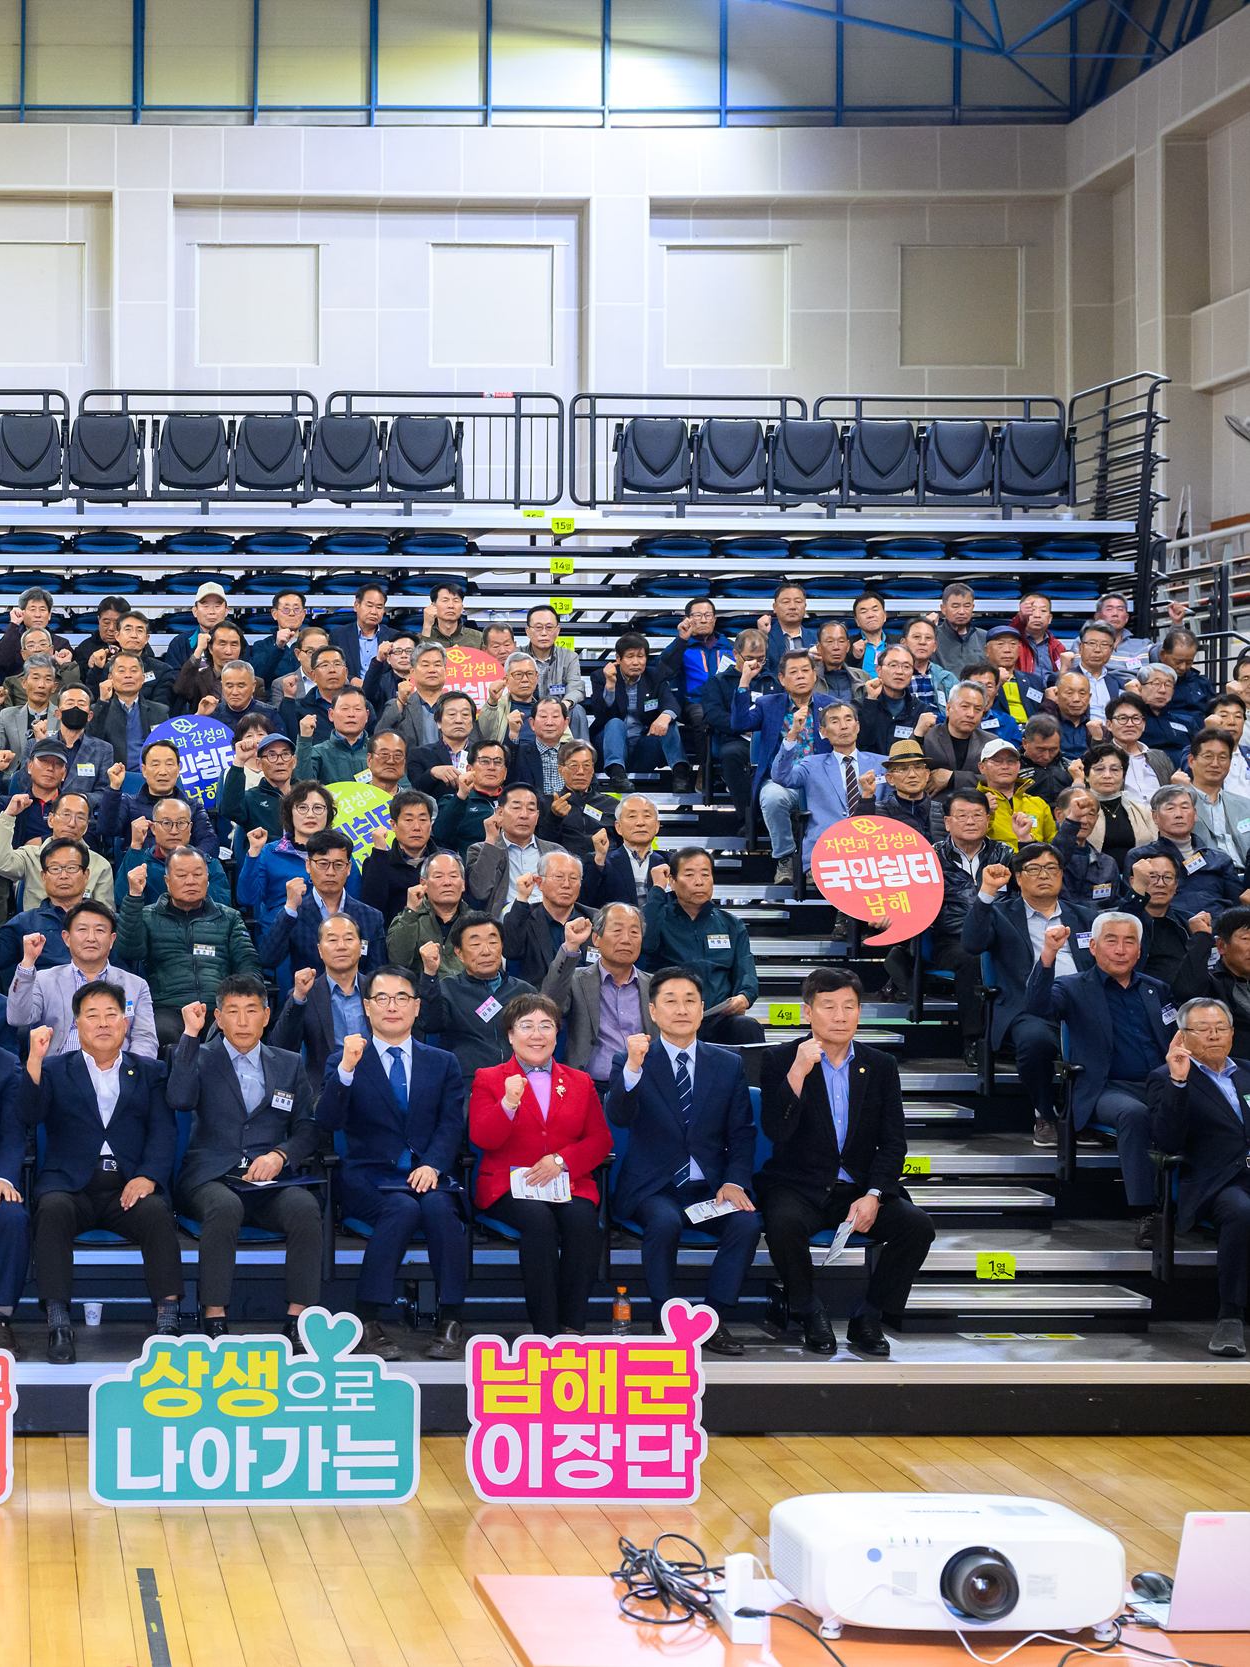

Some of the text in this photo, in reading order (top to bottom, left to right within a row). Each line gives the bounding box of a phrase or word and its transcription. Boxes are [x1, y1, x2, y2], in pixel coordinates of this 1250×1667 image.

[555, 521, 572, 531] 15열
[553, 561, 571, 571] 14열
[553, 602, 570, 611] 13열
[460, 661, 498, 678] 감성의
[188, 727, 227, 748] 감성의
[337, 789, 377, 814] 감성의
[823, 832, 918, 854] 자연과 감성의
[818, 851, 941, 892] 국민쉼터
[863, 890, 911, 917] 남해
[777, 1009, 792, 1020] 4열
[989, 1260, 1006, 1274] 1열
[139, 1349, 376, 1418] 상생으로
[481, 1348, 691, 1416] 남해군
[116, 1424, 399, 1493] 나아가는
[479, 1422, 694, 1490] 이장단
